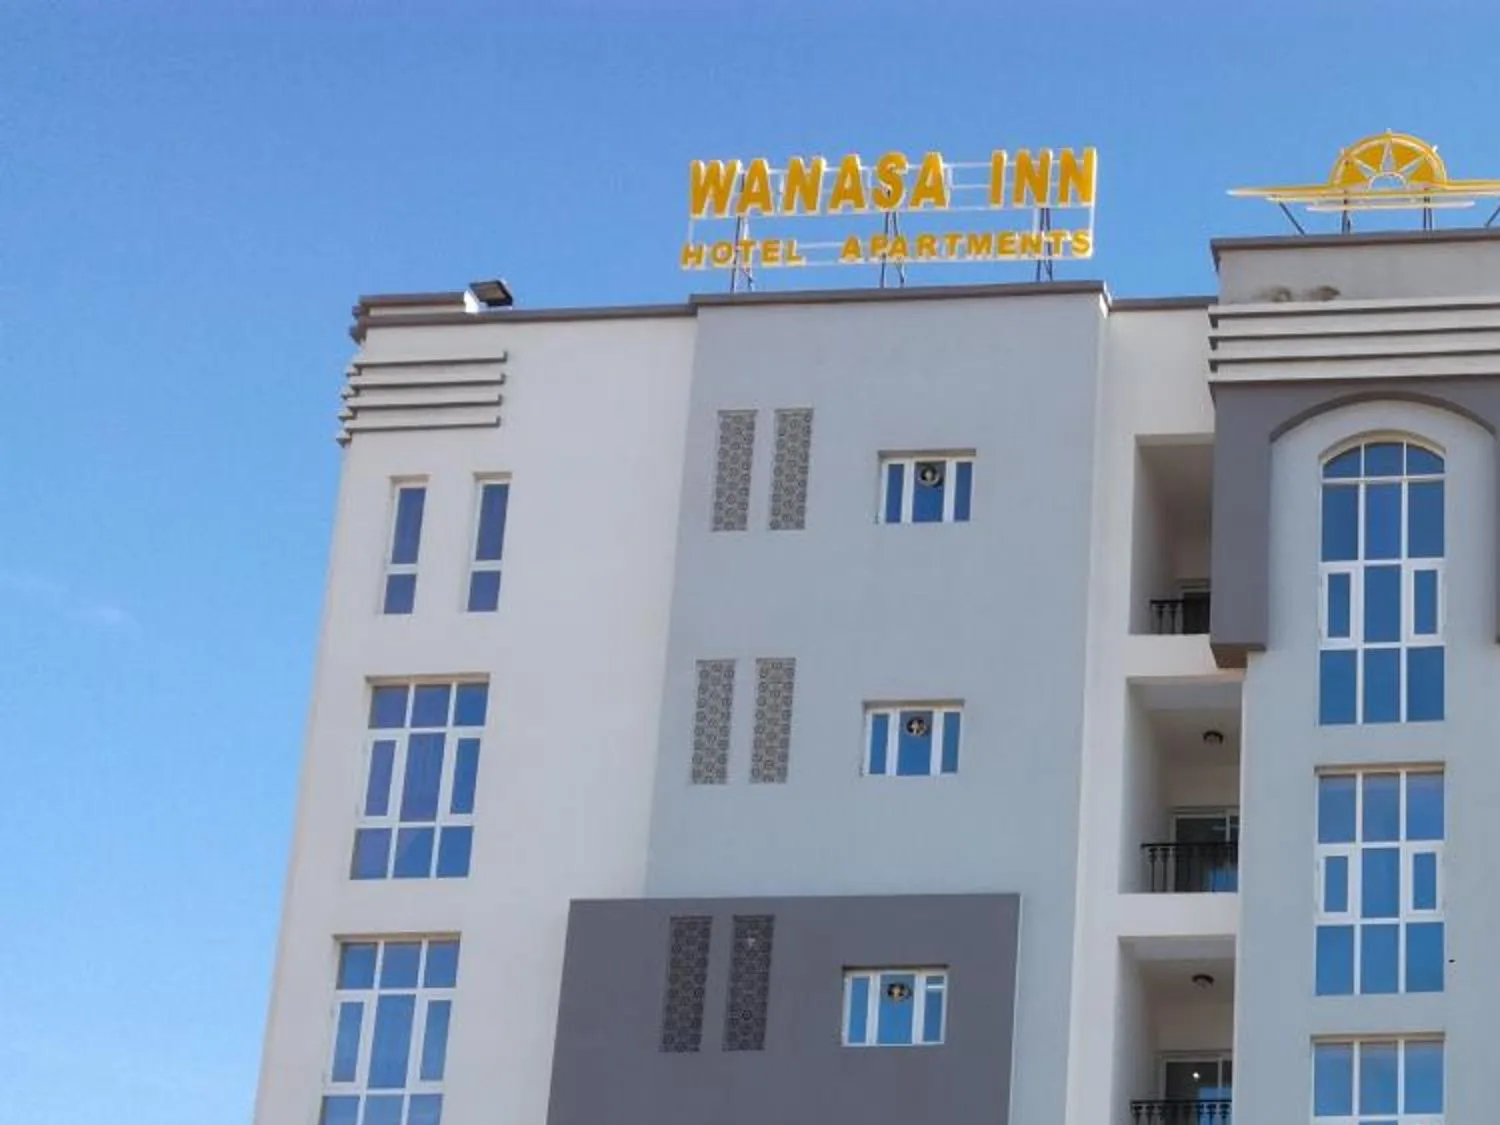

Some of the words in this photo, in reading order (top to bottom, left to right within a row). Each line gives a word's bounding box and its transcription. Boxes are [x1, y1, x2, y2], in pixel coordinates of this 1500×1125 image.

[689, 151, 951, 219] WANASA
[988, 146, 1097, 208] INN
[680, 240, 806, 270] HOTEL
[838, 229, 1094, 262] APARTMENTS
